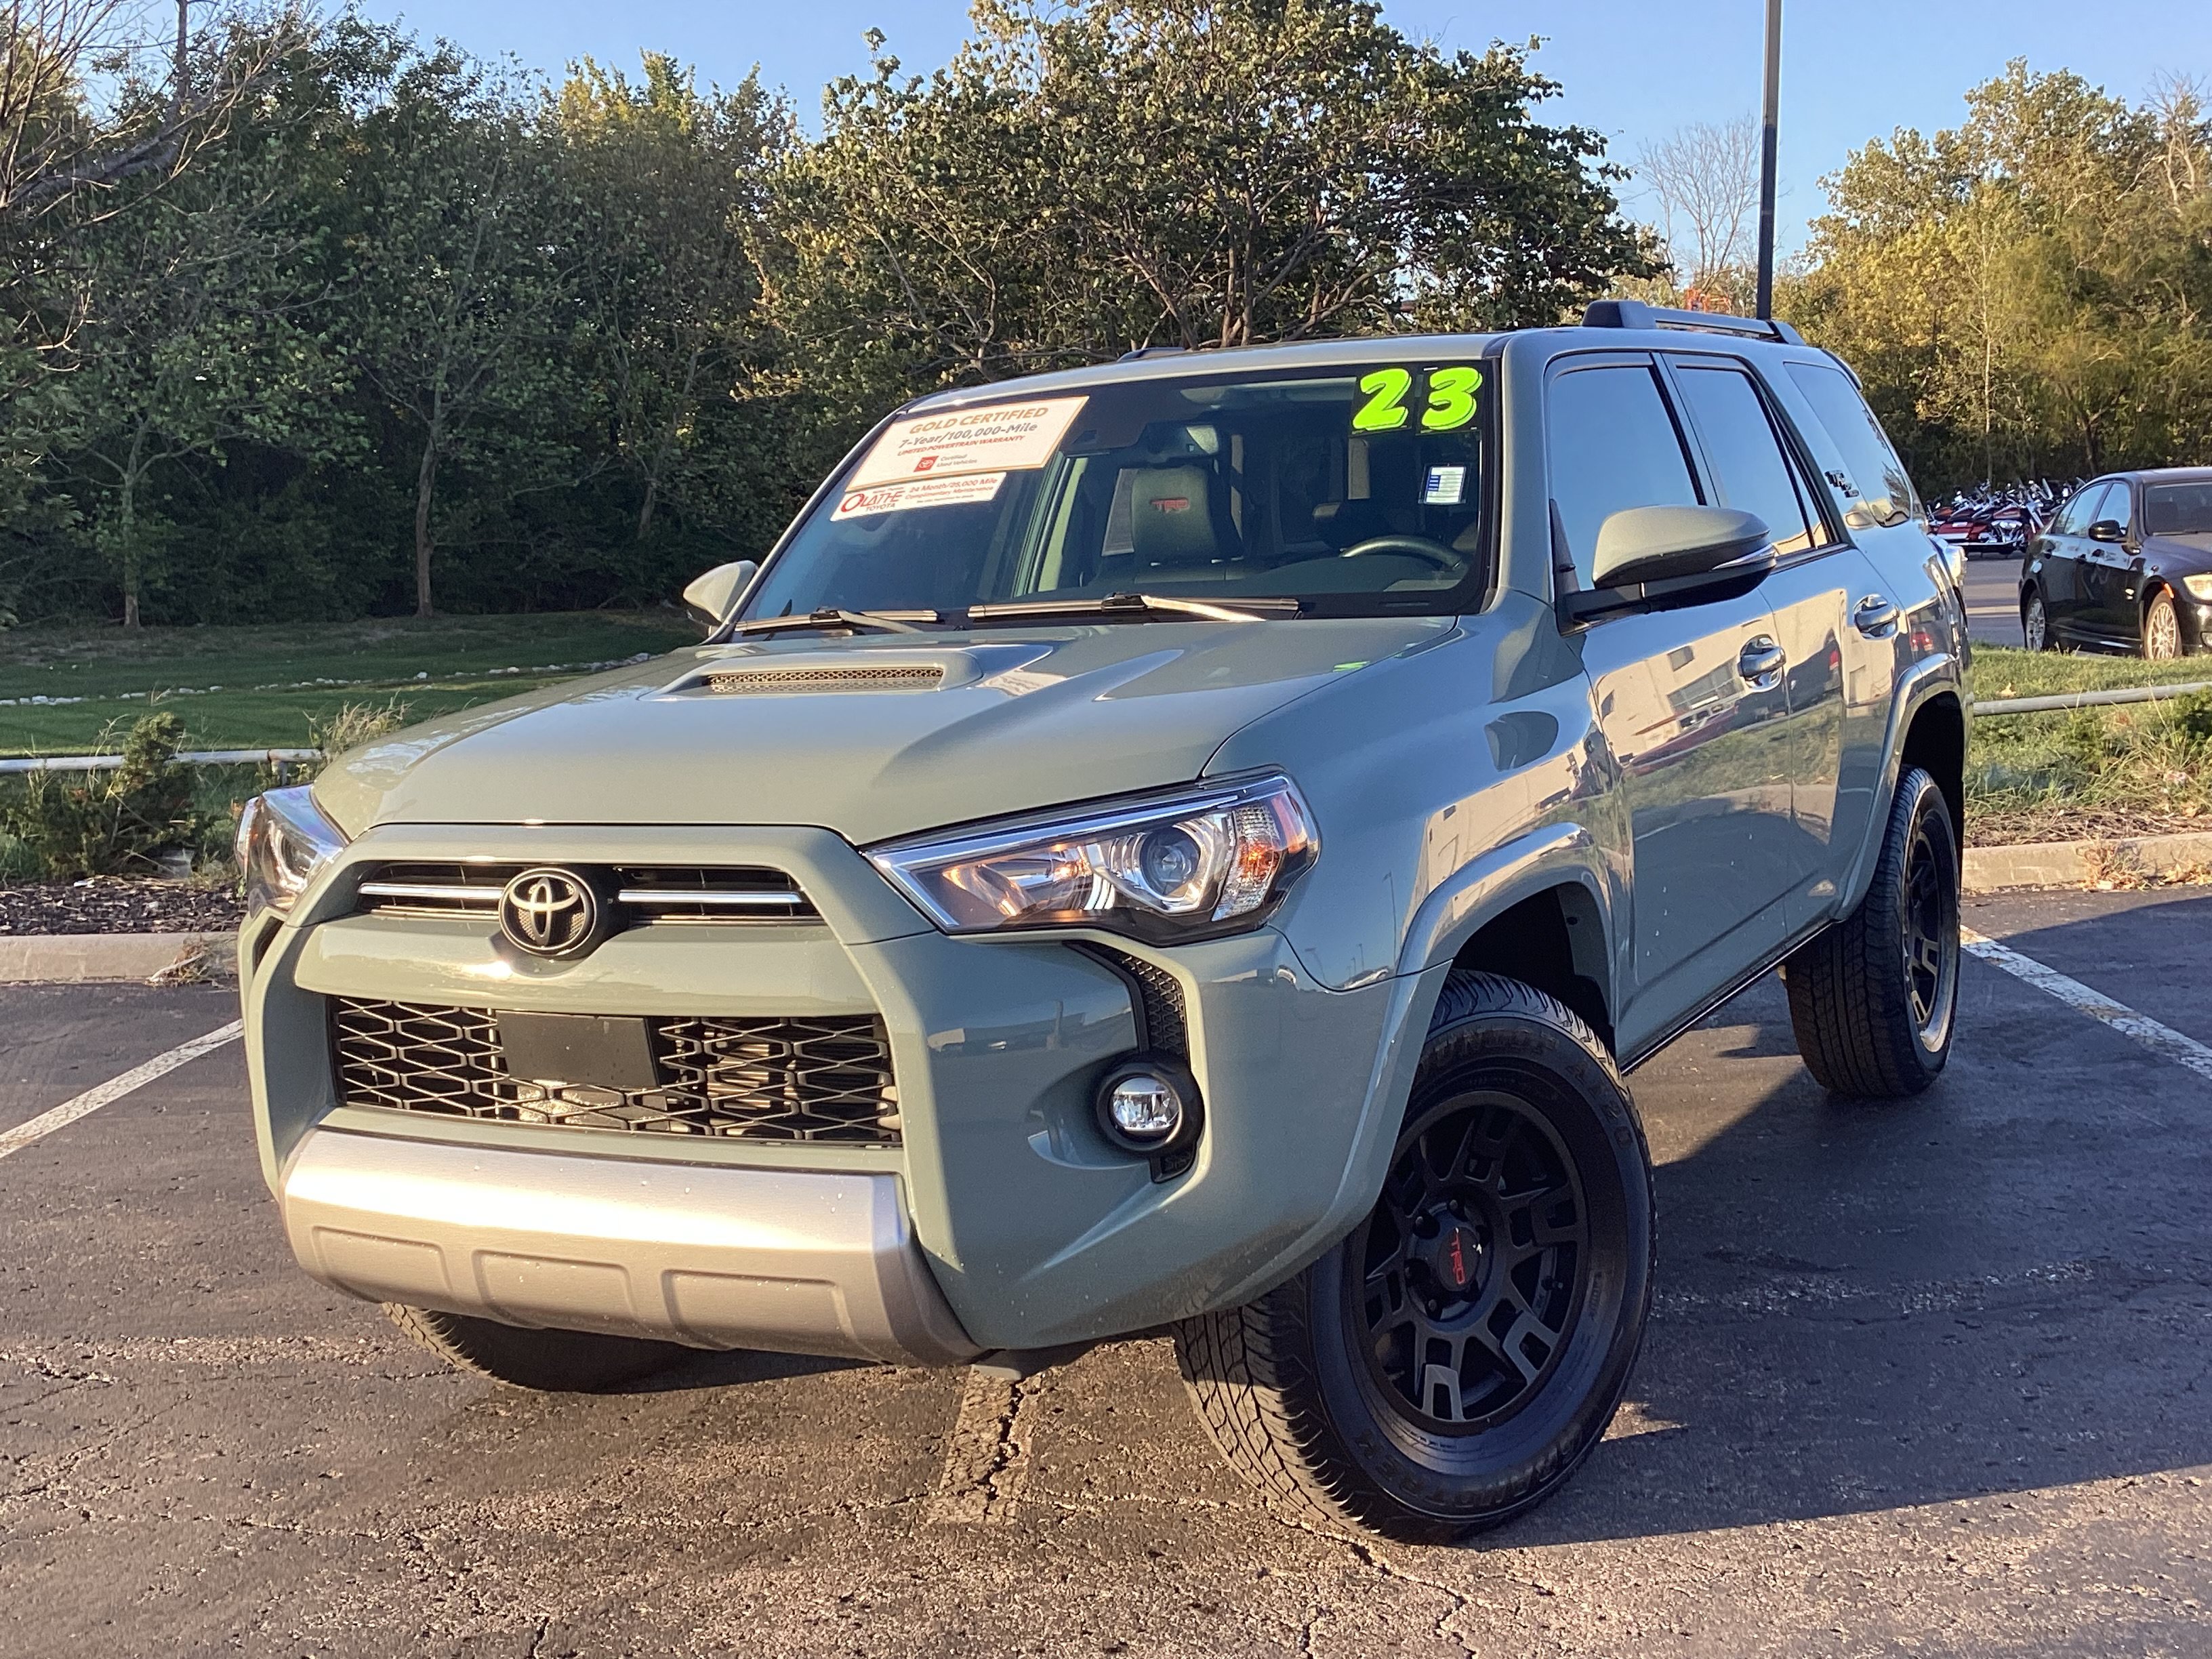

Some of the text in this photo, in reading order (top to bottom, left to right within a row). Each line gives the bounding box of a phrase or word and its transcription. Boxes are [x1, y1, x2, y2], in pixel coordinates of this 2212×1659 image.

[909, 407, 1049, 434] GOLD CERTIFIED
[897, 434, 1026, 456] LIMITED POWERTRAIN WARRANTY
[898, 422, 1038, 449] 7-Year/100,000-Mile
[841, 490, 905, 512] OLATHE
[865, 503, 896, 512] TOYOTA
[1451, 1229, 1466, 1285] TRD
